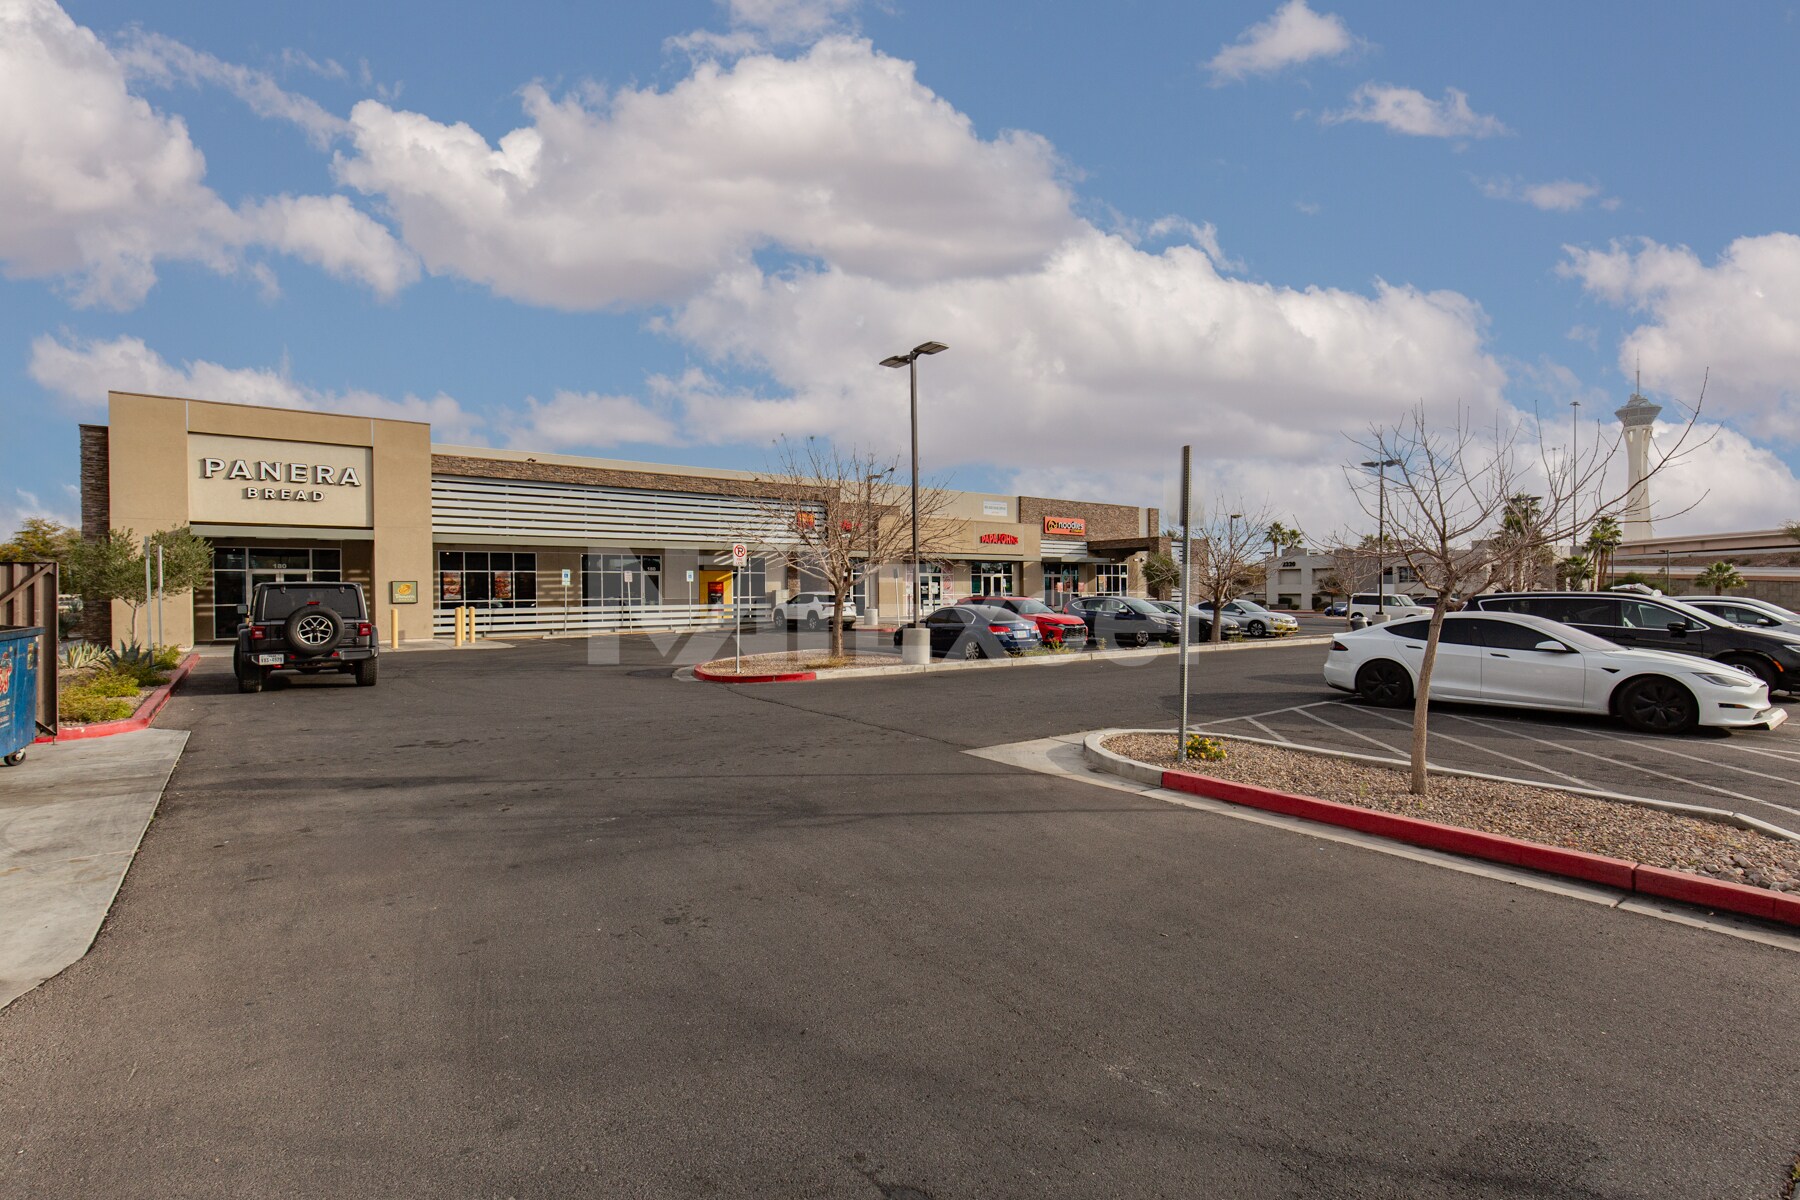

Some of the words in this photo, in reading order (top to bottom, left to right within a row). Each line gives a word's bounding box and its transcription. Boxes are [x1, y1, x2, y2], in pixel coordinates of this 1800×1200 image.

[203, 458, 361, 487] PANERA
[246, 487, 325, 502] BREAD
[1057, 521, 1084, 530] noodles
[980, 533, 997, 544] PAPA
